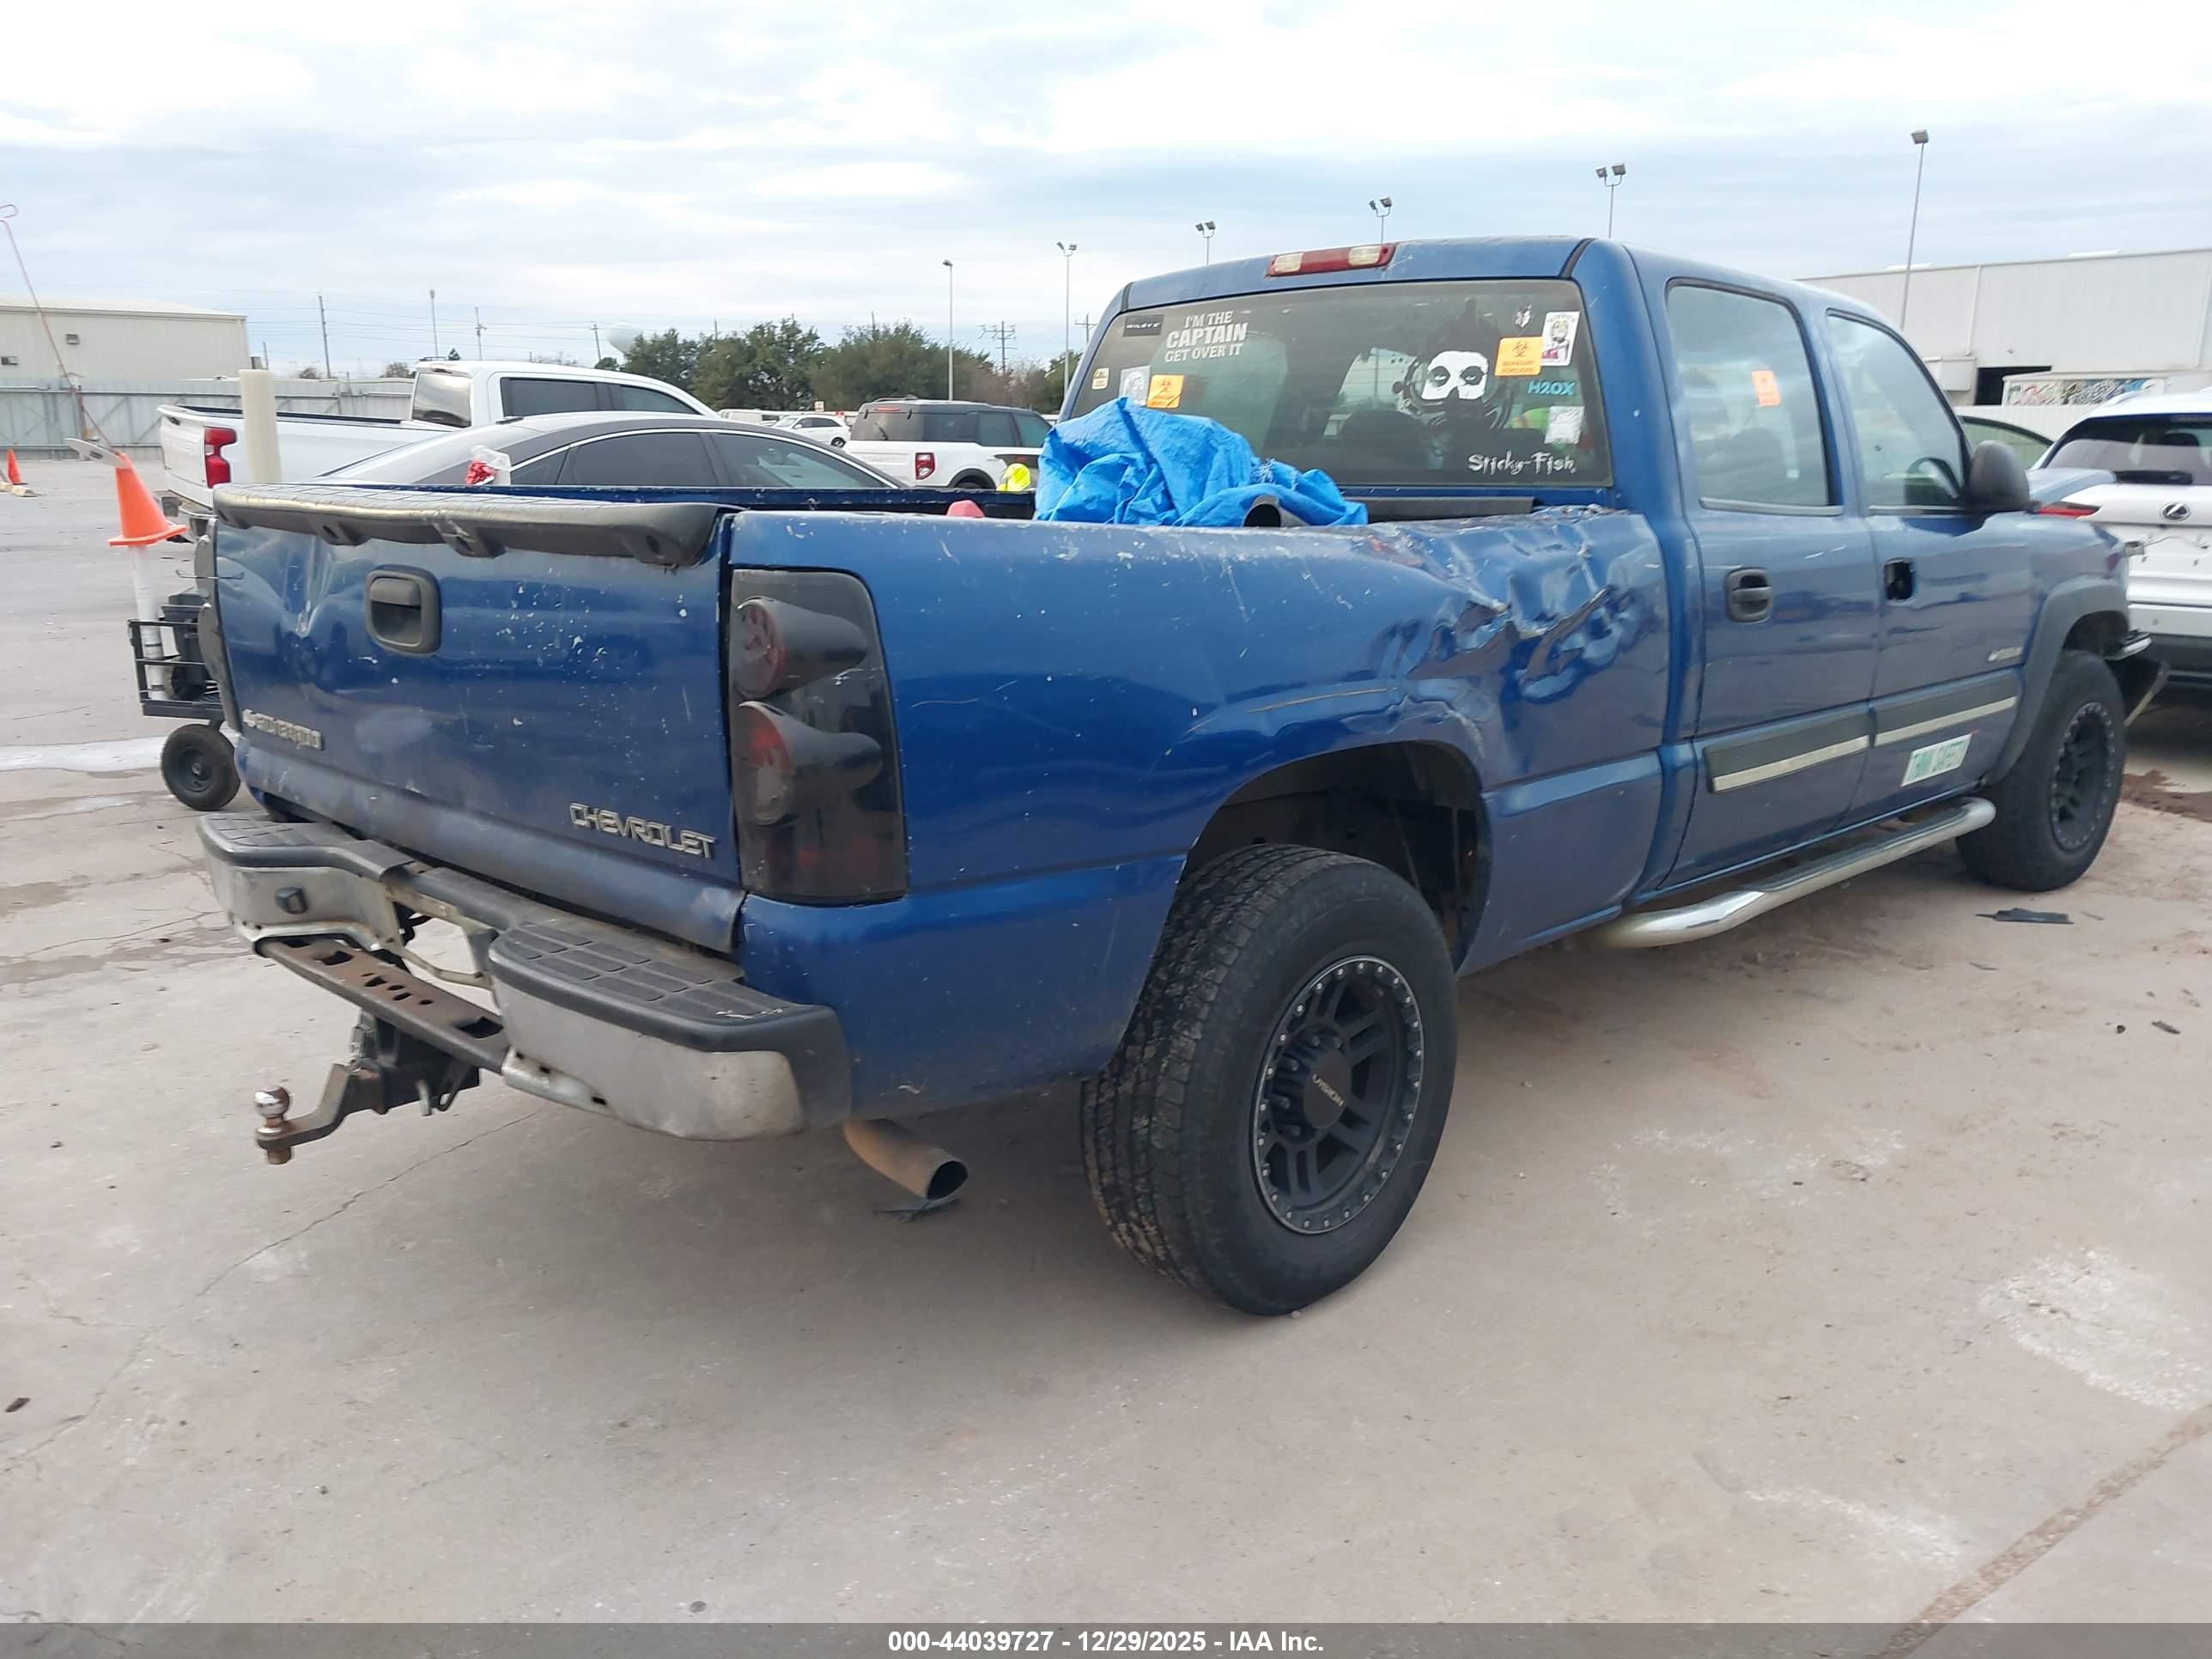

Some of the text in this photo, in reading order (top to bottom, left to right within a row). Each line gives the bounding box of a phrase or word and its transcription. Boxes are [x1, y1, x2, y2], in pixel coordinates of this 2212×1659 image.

[1184, 310, 1234, 328] I'M THE
[1166, 322, 1249, 349] CAPTAIN
[1164, 343, 1244, 362] GET OVER IT
[569, 802, 717, 859] CHEVROLET
[1312, 1073, 1345, 1107] VISION
